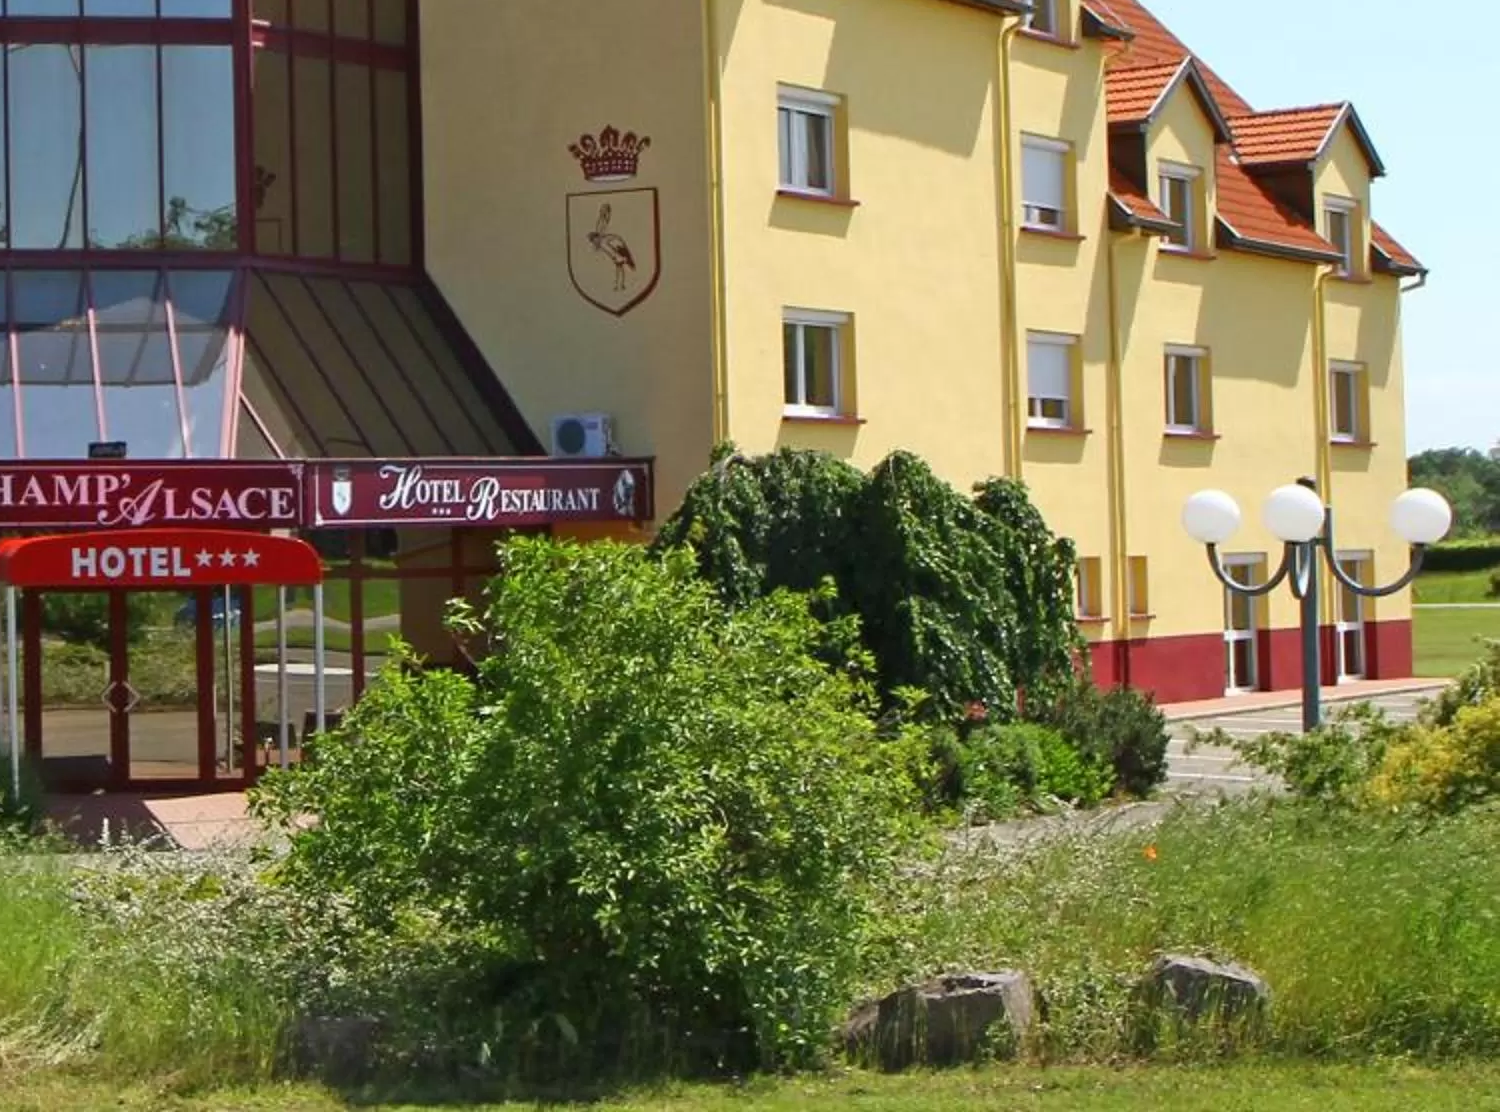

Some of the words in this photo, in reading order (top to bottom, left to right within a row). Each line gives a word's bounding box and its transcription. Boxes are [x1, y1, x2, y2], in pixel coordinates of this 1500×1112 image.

[379, 465, 465, 509] HOTEL
[466, 476, 601, 521] RESTAURANT
[71, 547, 192, 578] HOTEL
